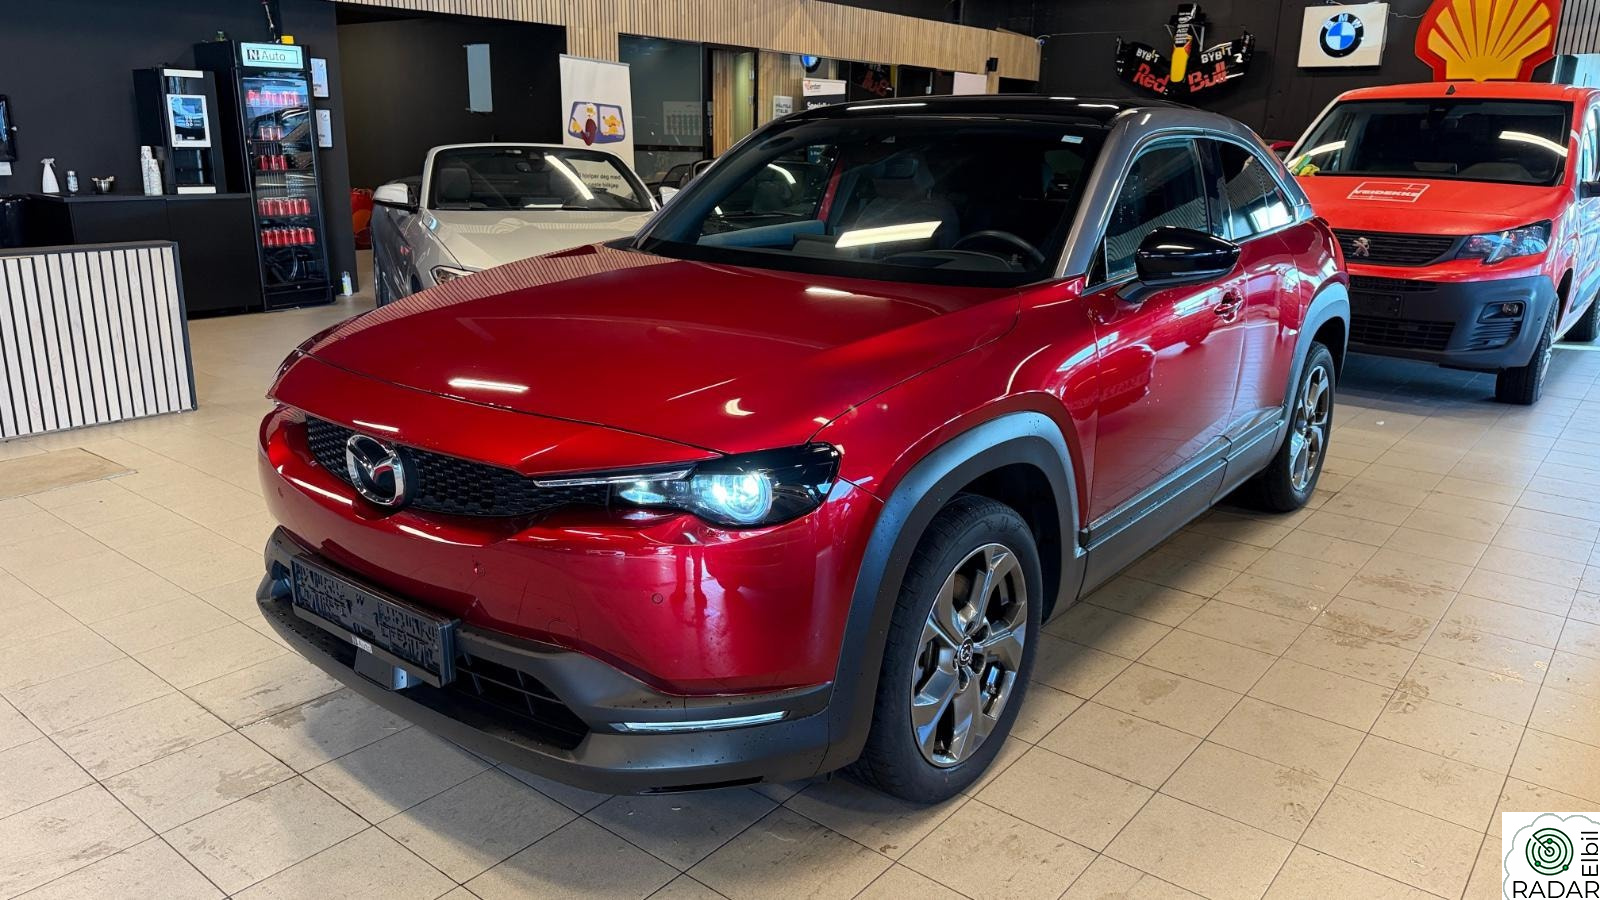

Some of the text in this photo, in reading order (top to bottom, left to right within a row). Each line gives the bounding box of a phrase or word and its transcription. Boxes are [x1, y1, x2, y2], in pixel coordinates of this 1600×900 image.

[262, 51, 286, 61] Auto
[1201, 46, 1232, 64] BYBIT
[1133, 61, 1229, 93] Red Bull
